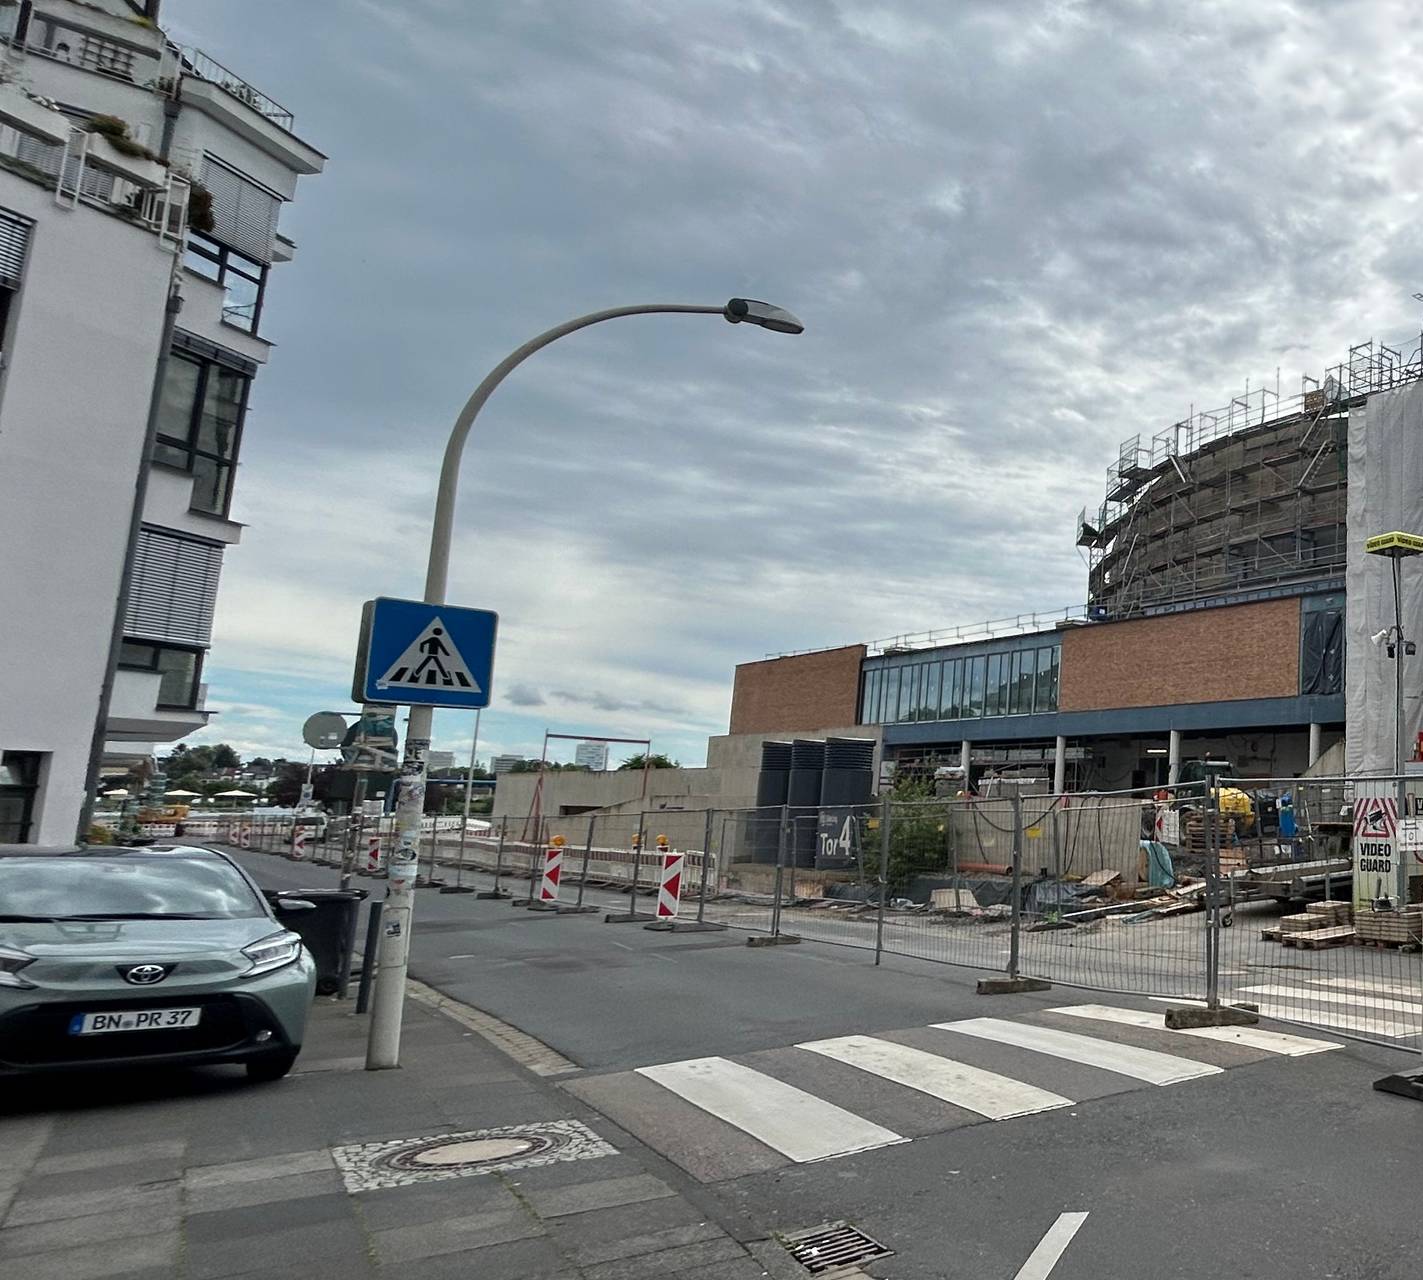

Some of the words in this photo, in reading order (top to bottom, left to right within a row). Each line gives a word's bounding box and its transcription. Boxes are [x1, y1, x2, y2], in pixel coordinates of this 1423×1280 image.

[820, 833, 838, 856] Tor
[839, 815, 850, 856] 4
[1360, 843, 1391, 856] VIDEO
[1360, 858, 1391, 873] GUARD
[92, 1014, 122, 1030] BN
[135, 1012, 162, 1028] PR
[166, 1010, 193, 1025] 37
